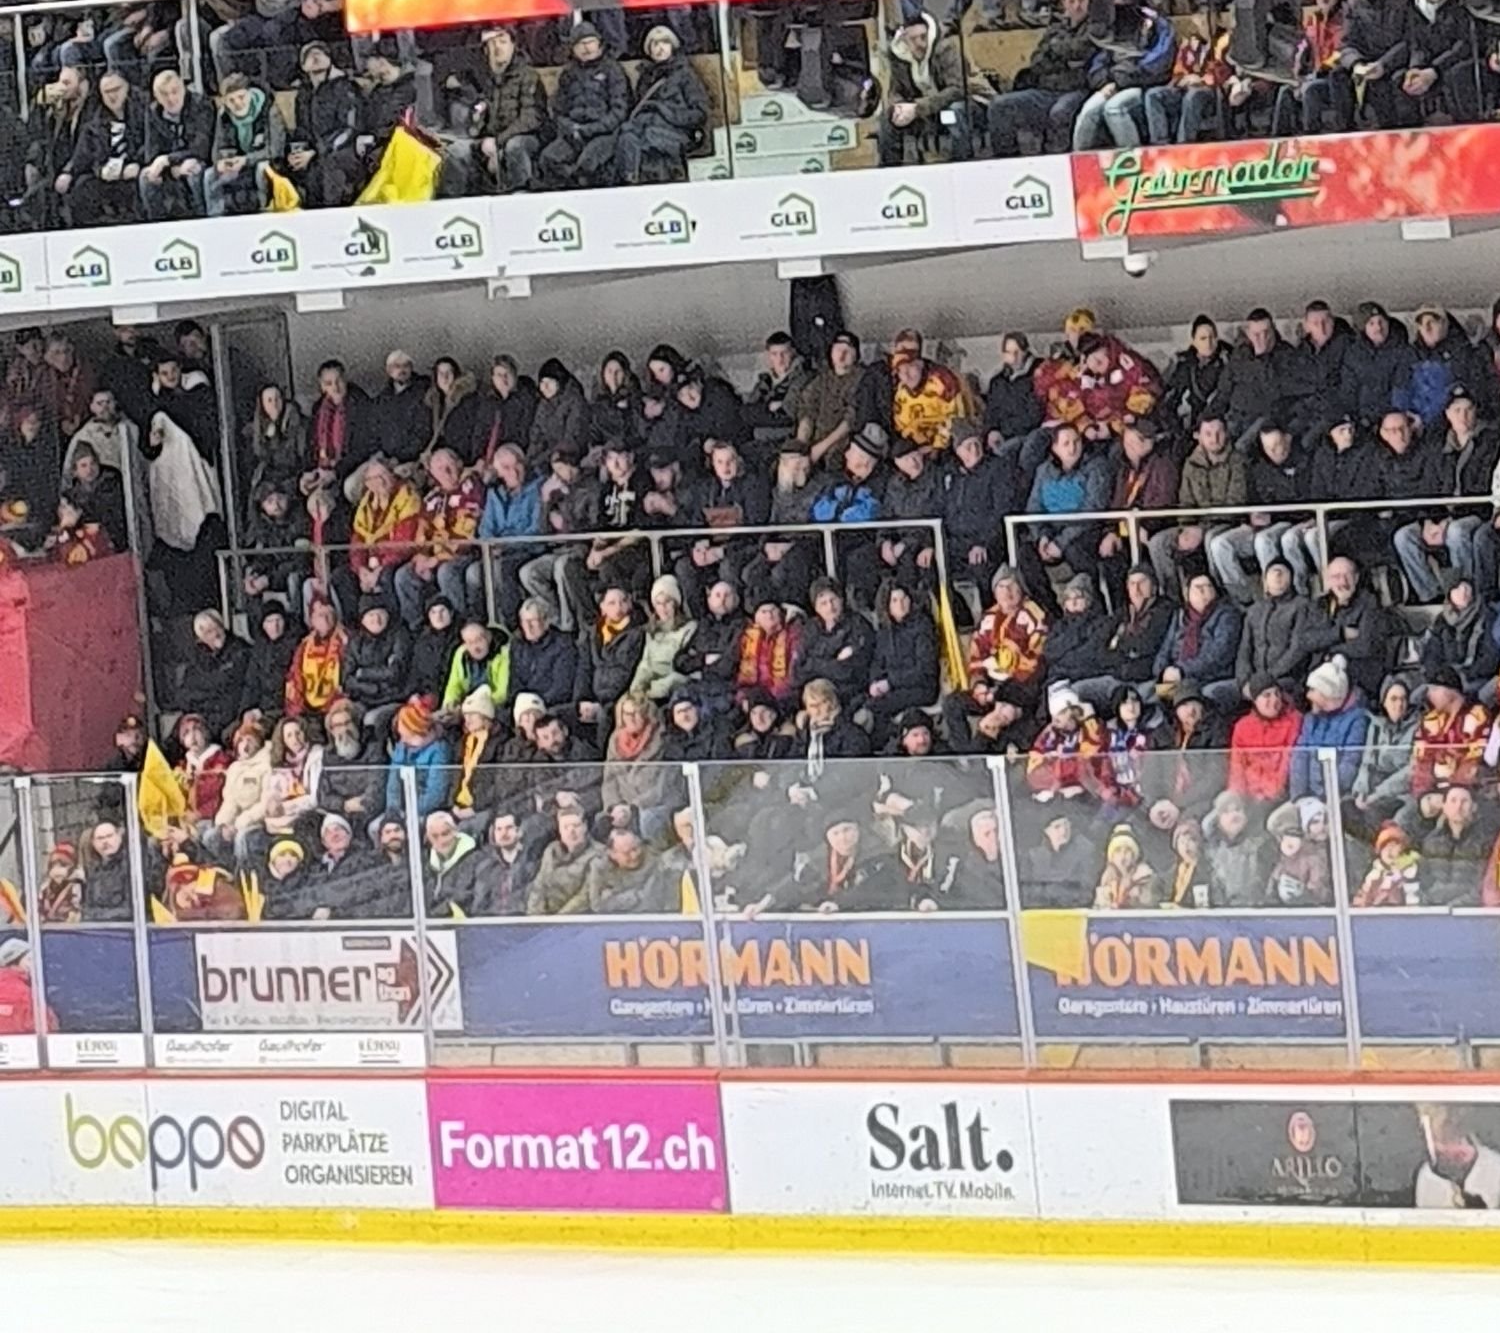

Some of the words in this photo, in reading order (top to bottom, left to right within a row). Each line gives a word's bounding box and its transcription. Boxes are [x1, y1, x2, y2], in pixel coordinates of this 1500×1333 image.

[1101, 141, 1323, 236] Gourmador
[1005, 193, 1044, 210] GLB
[770, 211, 809, 227] GLB
[881, 203, 920, 219] GLB
[538, 227, 574, 243] GLB
[643, 219, 683, 236] GLB
[435, 234, 475, 250] GLB
[251, 247, 290, 264] GLB
[154, 256, 194, 273] GLB
[605, 935, 871, 989] HÖRMANN
[200, 954, 372, 1003] brunner
[279, 1100, 349, 1122] DIGITAL
[282, 1128, 390, 1154] PARKPLÄTZE
[866, 1100, 1014, 1173] Salt.
[285, 1164, 414, 1186] ORGANISIEREN
